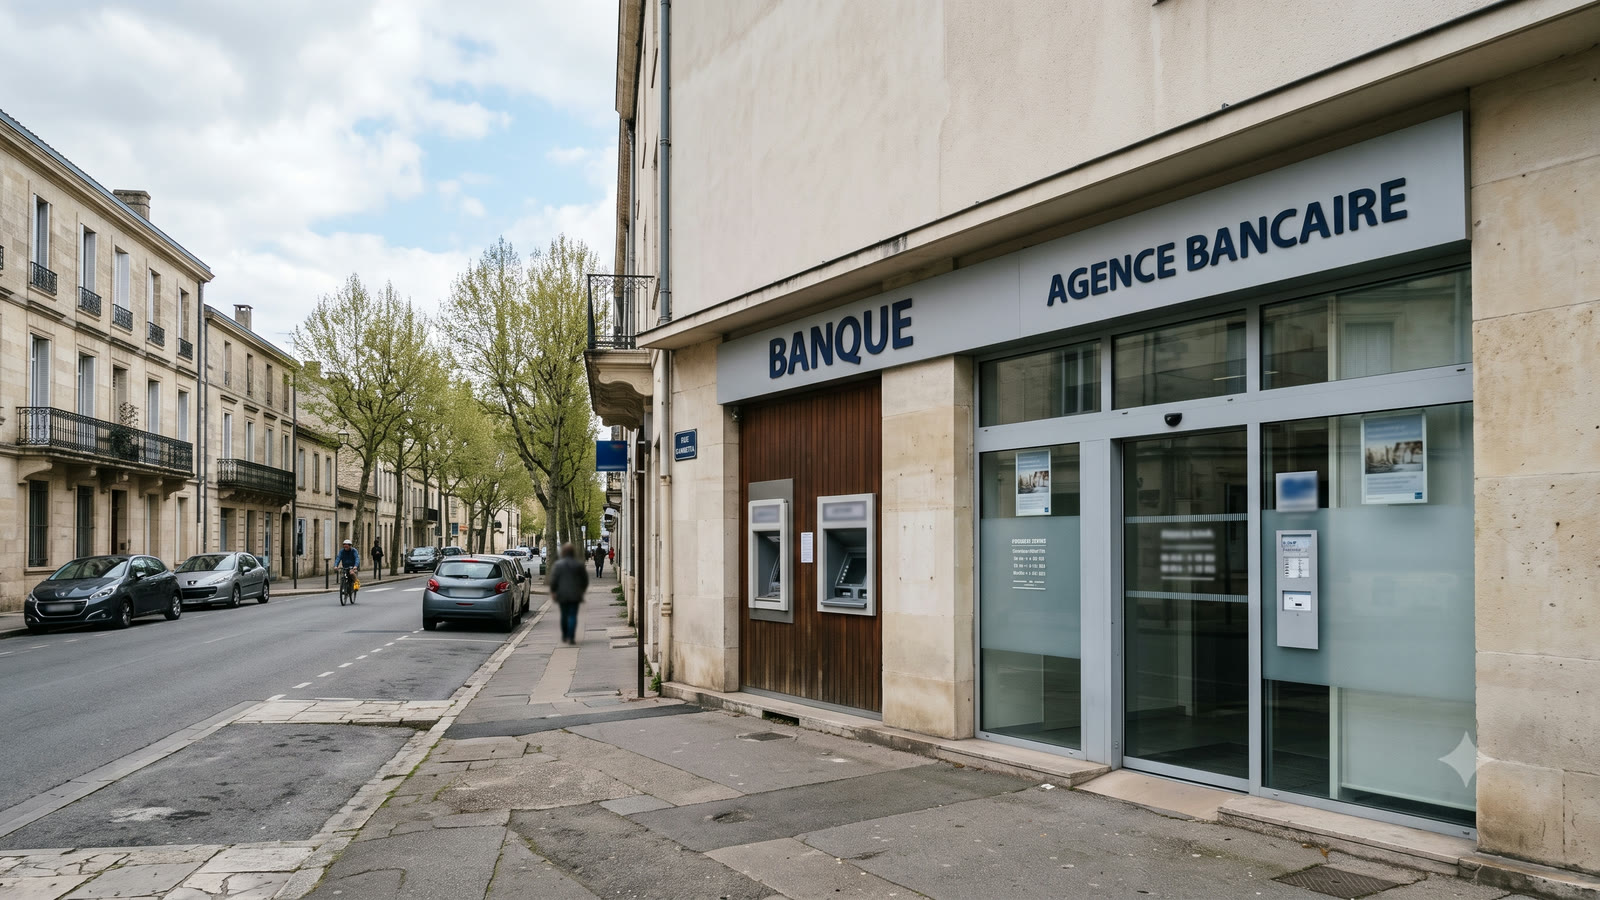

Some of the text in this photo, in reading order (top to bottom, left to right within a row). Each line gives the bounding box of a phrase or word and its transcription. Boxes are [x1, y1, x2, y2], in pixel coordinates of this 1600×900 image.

[1047, 177, 1408, 307] AGENCE BANCAIRE
[769, 298, 914, 379] BANQUE
[680, 435, 690, 444] RUE
